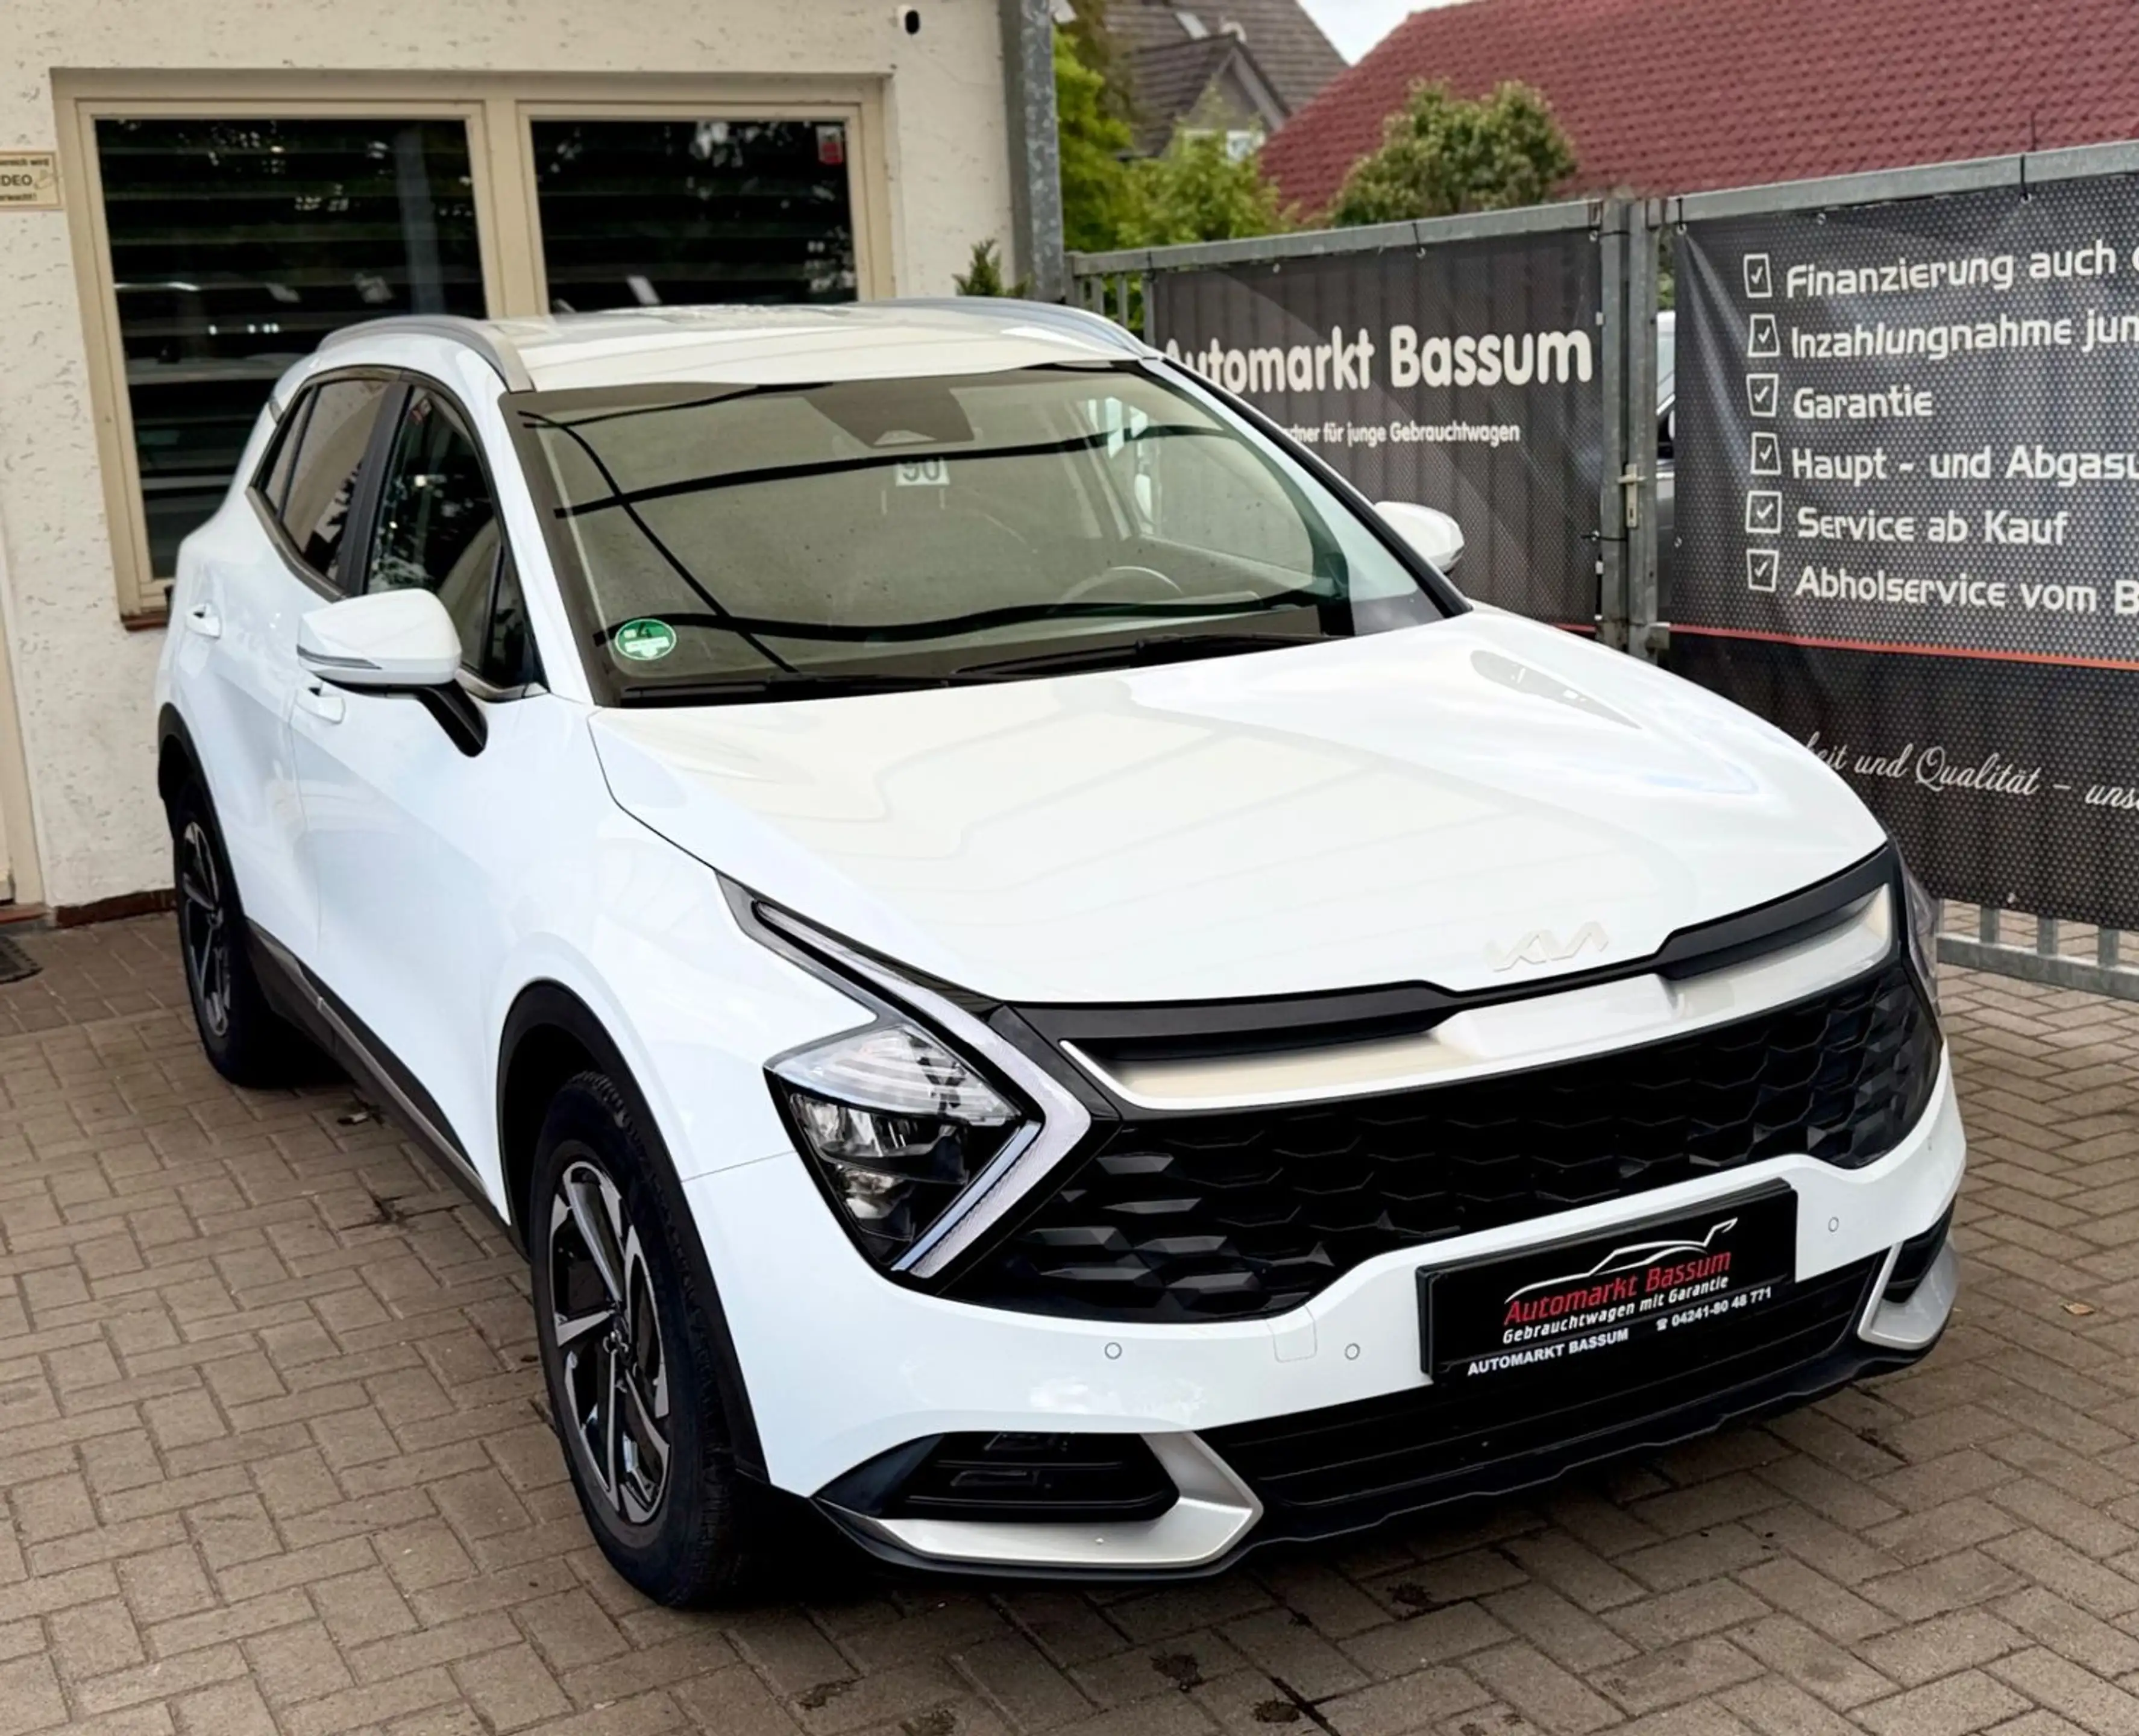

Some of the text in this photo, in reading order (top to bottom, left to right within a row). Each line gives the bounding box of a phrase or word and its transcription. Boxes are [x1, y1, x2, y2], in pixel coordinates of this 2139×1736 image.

[0, 174, 33, 187] DEO
[1786, 254, 2014, 298] Finanzierung
[2029, 239, 2117, 279] auch
[1390, 324, 1592, 387] Bassum
[1791, 313, 2072, 360] Inzahlungnahme
[1794, 384, 1933, 420] Garantie
[1324, 422, 1345, 442] für
[1346, 421, 1386, 447] junge
[1390, 421, 1521, 447] Gebrauchtwagen
[1792, 447, 1887, 486] Haupt
[1930, 445, 1991, 479] und
[1797, 507, 2068, 546] Service ab Kauf
[1795, 565, 2006, 608] Abholservice
[2020, 582, 2097, 613] vom
[1854, 743, 1914, 778] und
[1915, 746, 2042, 796] Qualität
[1503, 1275, 1729, 1344] Gebrauchtwagen mit Garantie
[1504, 1251, 1732, 1326] Automarkt Bassum
[1467, 1343, 1565, 1376] AUTOMARKT
[1568, 1328, 1629, 1354] BASSUM
[1750, 1286, 1772, 1303] 771
